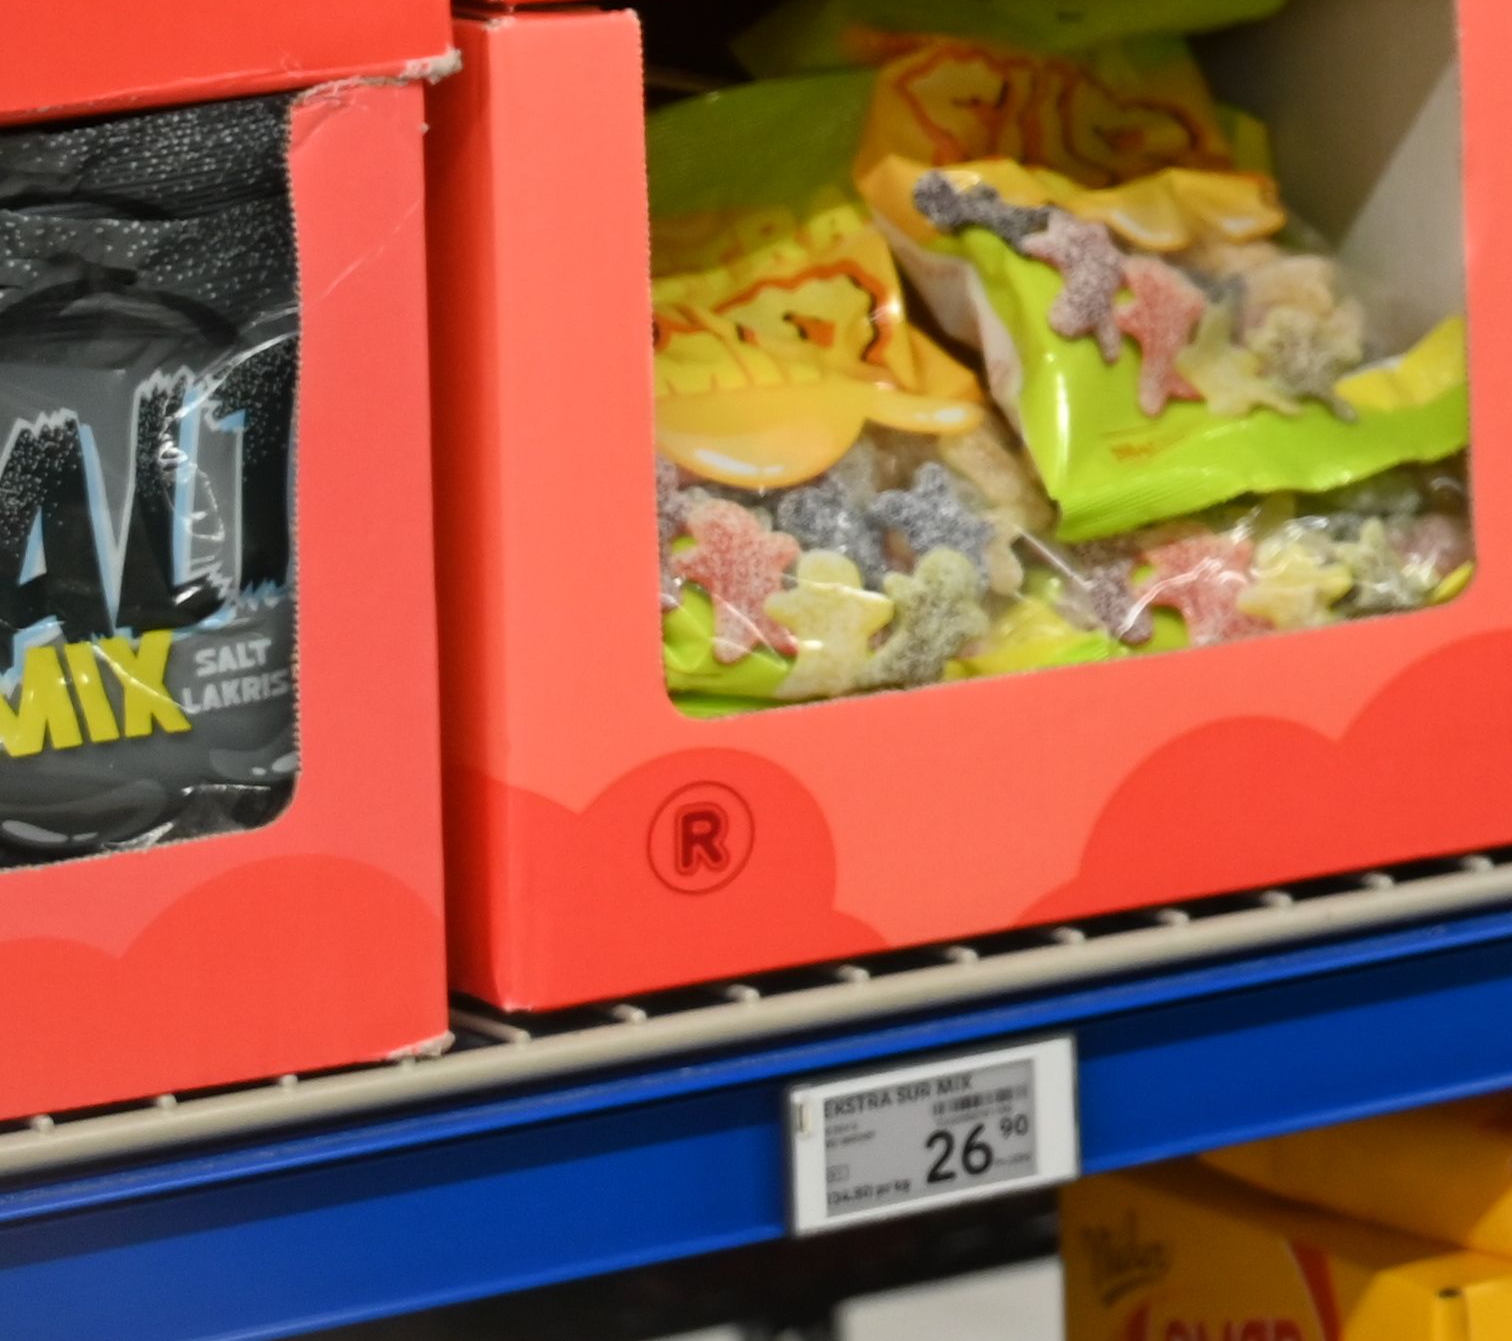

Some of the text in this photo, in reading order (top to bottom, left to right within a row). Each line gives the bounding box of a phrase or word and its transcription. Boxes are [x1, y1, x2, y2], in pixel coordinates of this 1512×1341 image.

[0, 336, 299, 640] ALT
[195, 638, 272, 676] SALT
[182, 672, 292, 715] LAKRIS
[824, 1074, 972, 1119] EKSTRA SUR MIX
[925, 1123, 994, 1184] 26
[1001, 1113, 1028, 1140] 90
